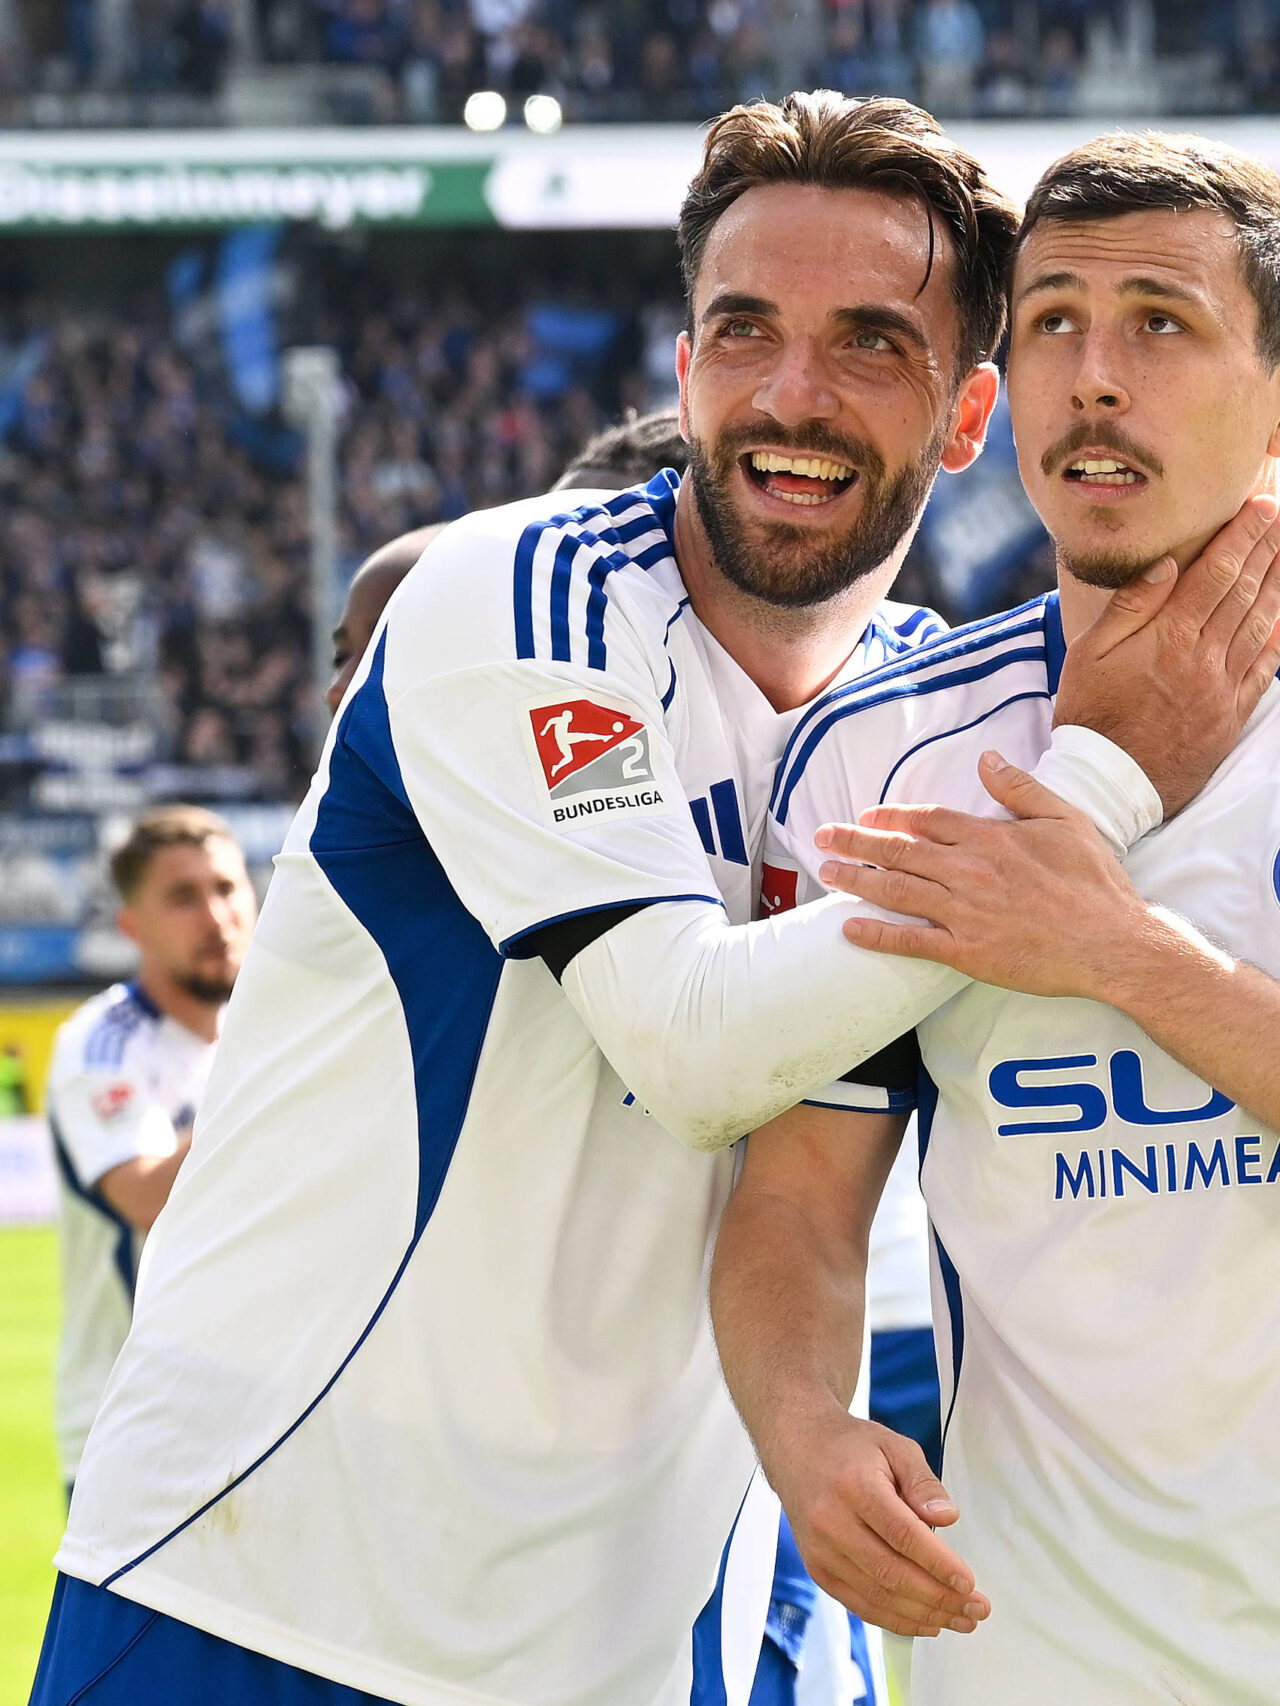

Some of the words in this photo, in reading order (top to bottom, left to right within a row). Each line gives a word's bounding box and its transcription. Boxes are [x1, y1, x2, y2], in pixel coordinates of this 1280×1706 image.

[618, 738, 649, 780] 2
[553, 790, 663, 823] BUNDESLIGA
[987, 1048, 1238, 1137] SU
